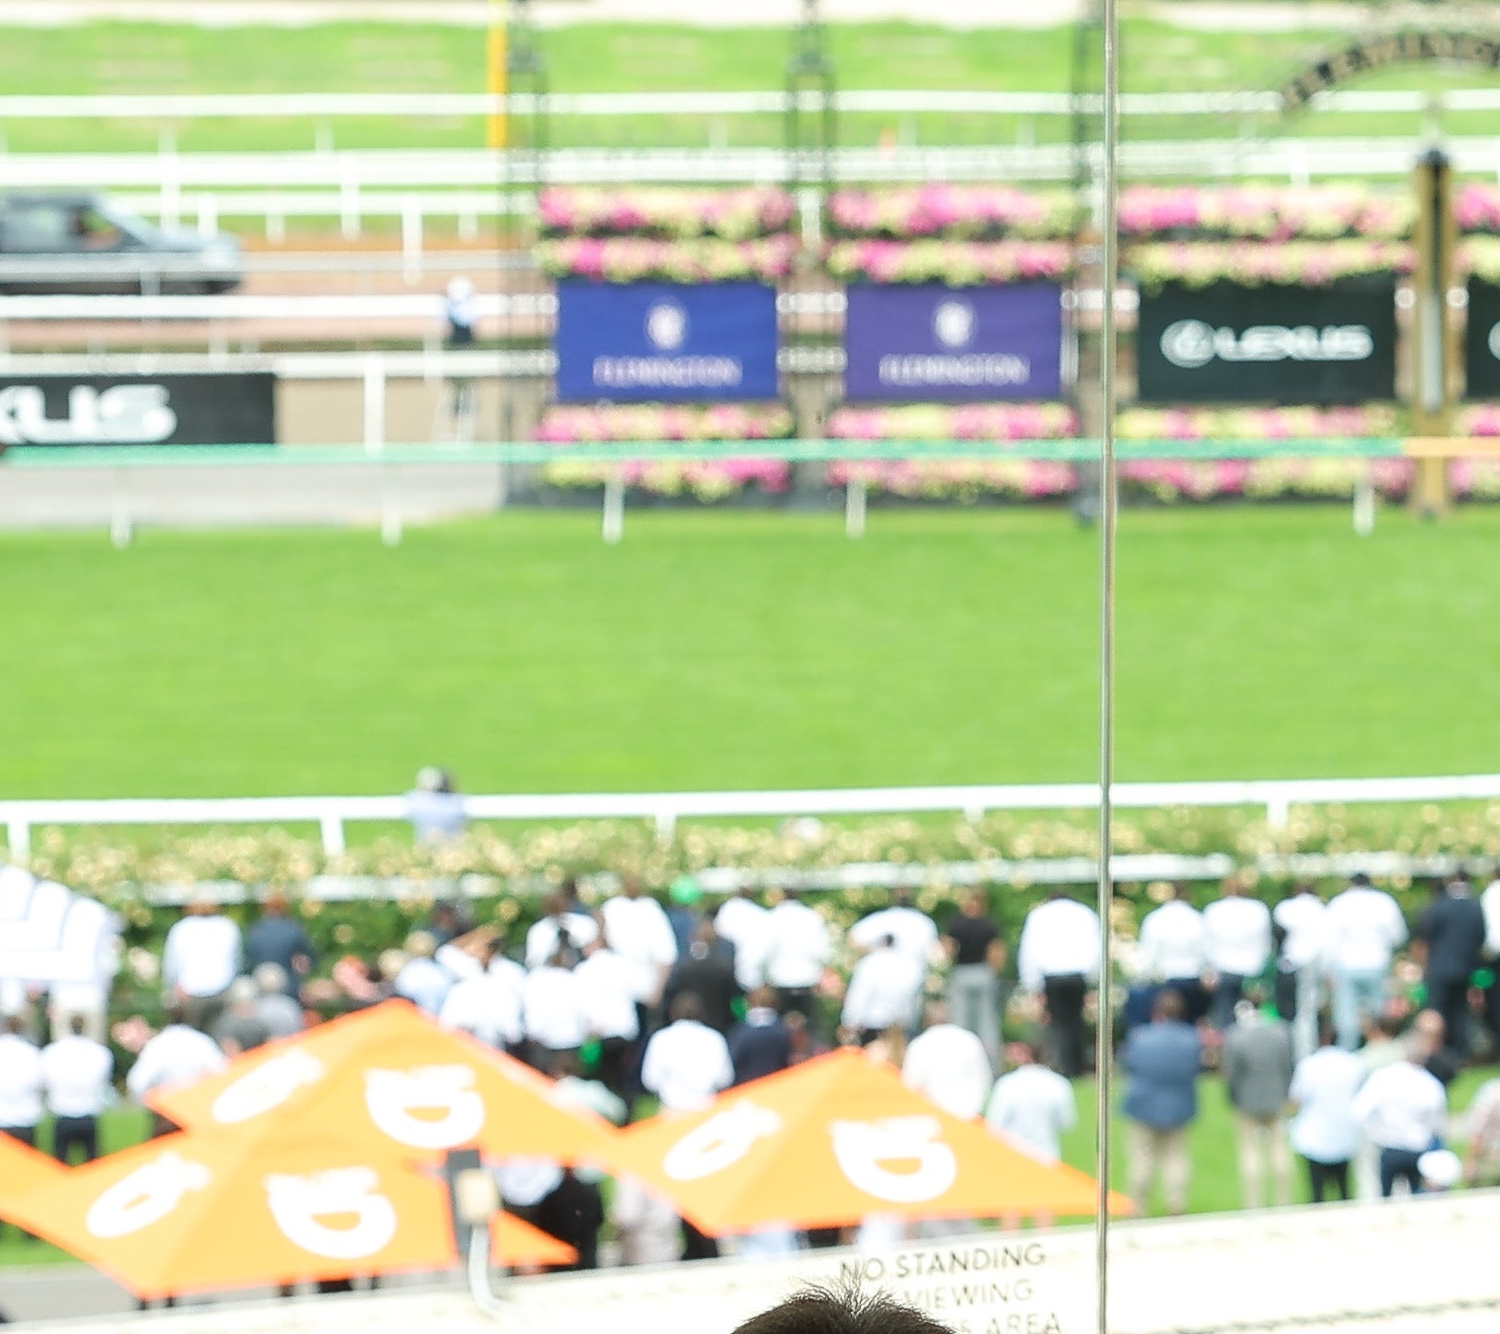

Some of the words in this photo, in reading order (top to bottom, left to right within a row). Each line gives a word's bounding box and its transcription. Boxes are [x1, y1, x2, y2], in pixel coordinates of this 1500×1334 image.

[1214, 325, 1373, 361] LEXUS
[839, 1256, 885, 1281] NO
[896, 1243, 1046, 1278] STANDING
[903, 1278, 1033, 1309] VIEWING
